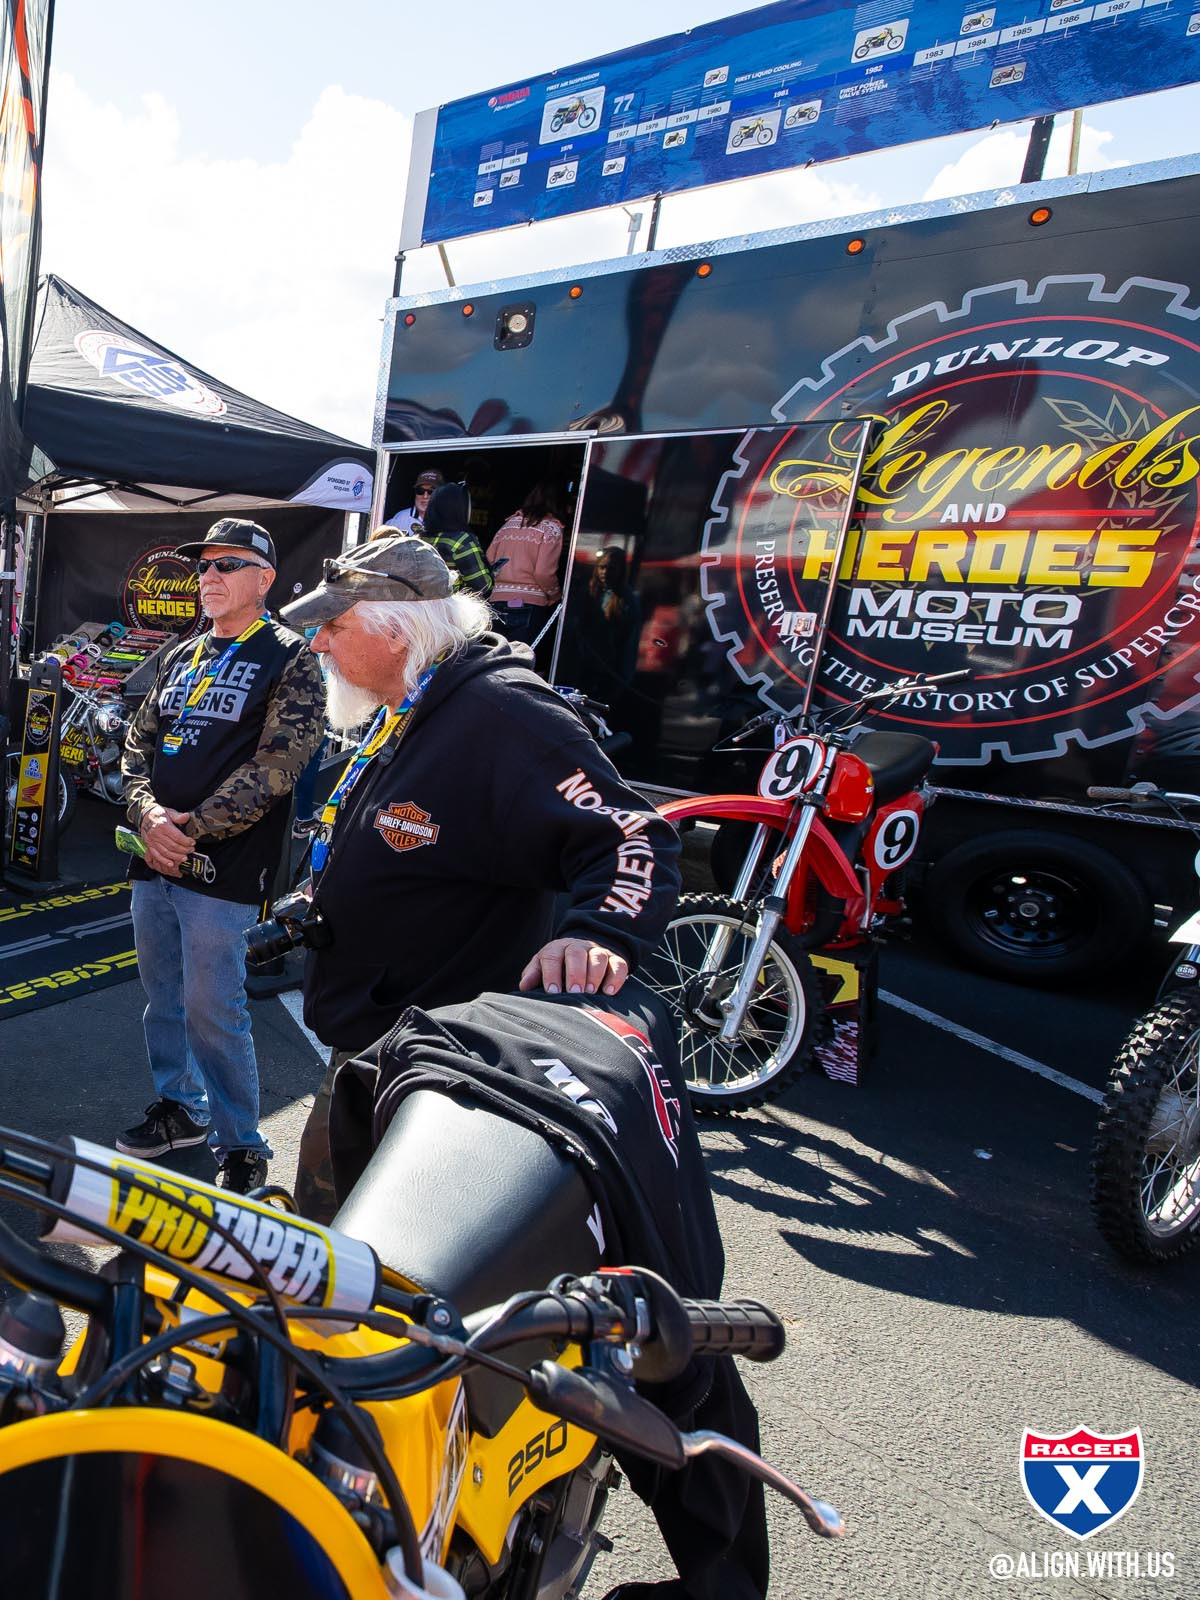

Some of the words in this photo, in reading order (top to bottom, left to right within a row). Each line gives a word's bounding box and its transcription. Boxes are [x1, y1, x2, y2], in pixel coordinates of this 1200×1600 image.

[1107, 1, 1130, 13] 1987
[1012, 27, 1032, 37] 1985
[1058, 15, 1080, 26] 1986
[925, 49, 944, 60] 1983
[967, 38, 987, 49] 1984
[865, 65, 884, 75] 1982
[614, 93, 635, 115] 77
[887, 337, 1170, 397] DUNLOP
[769, 400, 1200, 523] Legends
[939, 503, 1007, 523] AND
[802, 529, 1163, 588] HEROES
[128, 564, 200, 599] Legends
[137, 599, 196, 617] HEROES
[847, 588, 1083, 625] MOTO
[847, 618, 1074, 649] MUSEUM
[214, 660, 262, 690] LEE
[823, 657, 877, 694] THE
[884, 682, 1017, 712] ISTORY
[1023, 676, 1069, 705] OF
[161, 690, 237, 715] DEGNS
[395, 706, 415, 738] Nikon
[769, 744, 813, 796] 9
[379, 814, 434, 838] HARLEY-DAVIDSON
[393, 806, 423, 822] MOTOR
[387, 830, 417, 847] CYCLES
[883, 816, 915, 865] 9
[508, 1418, 568, 1498] 250
